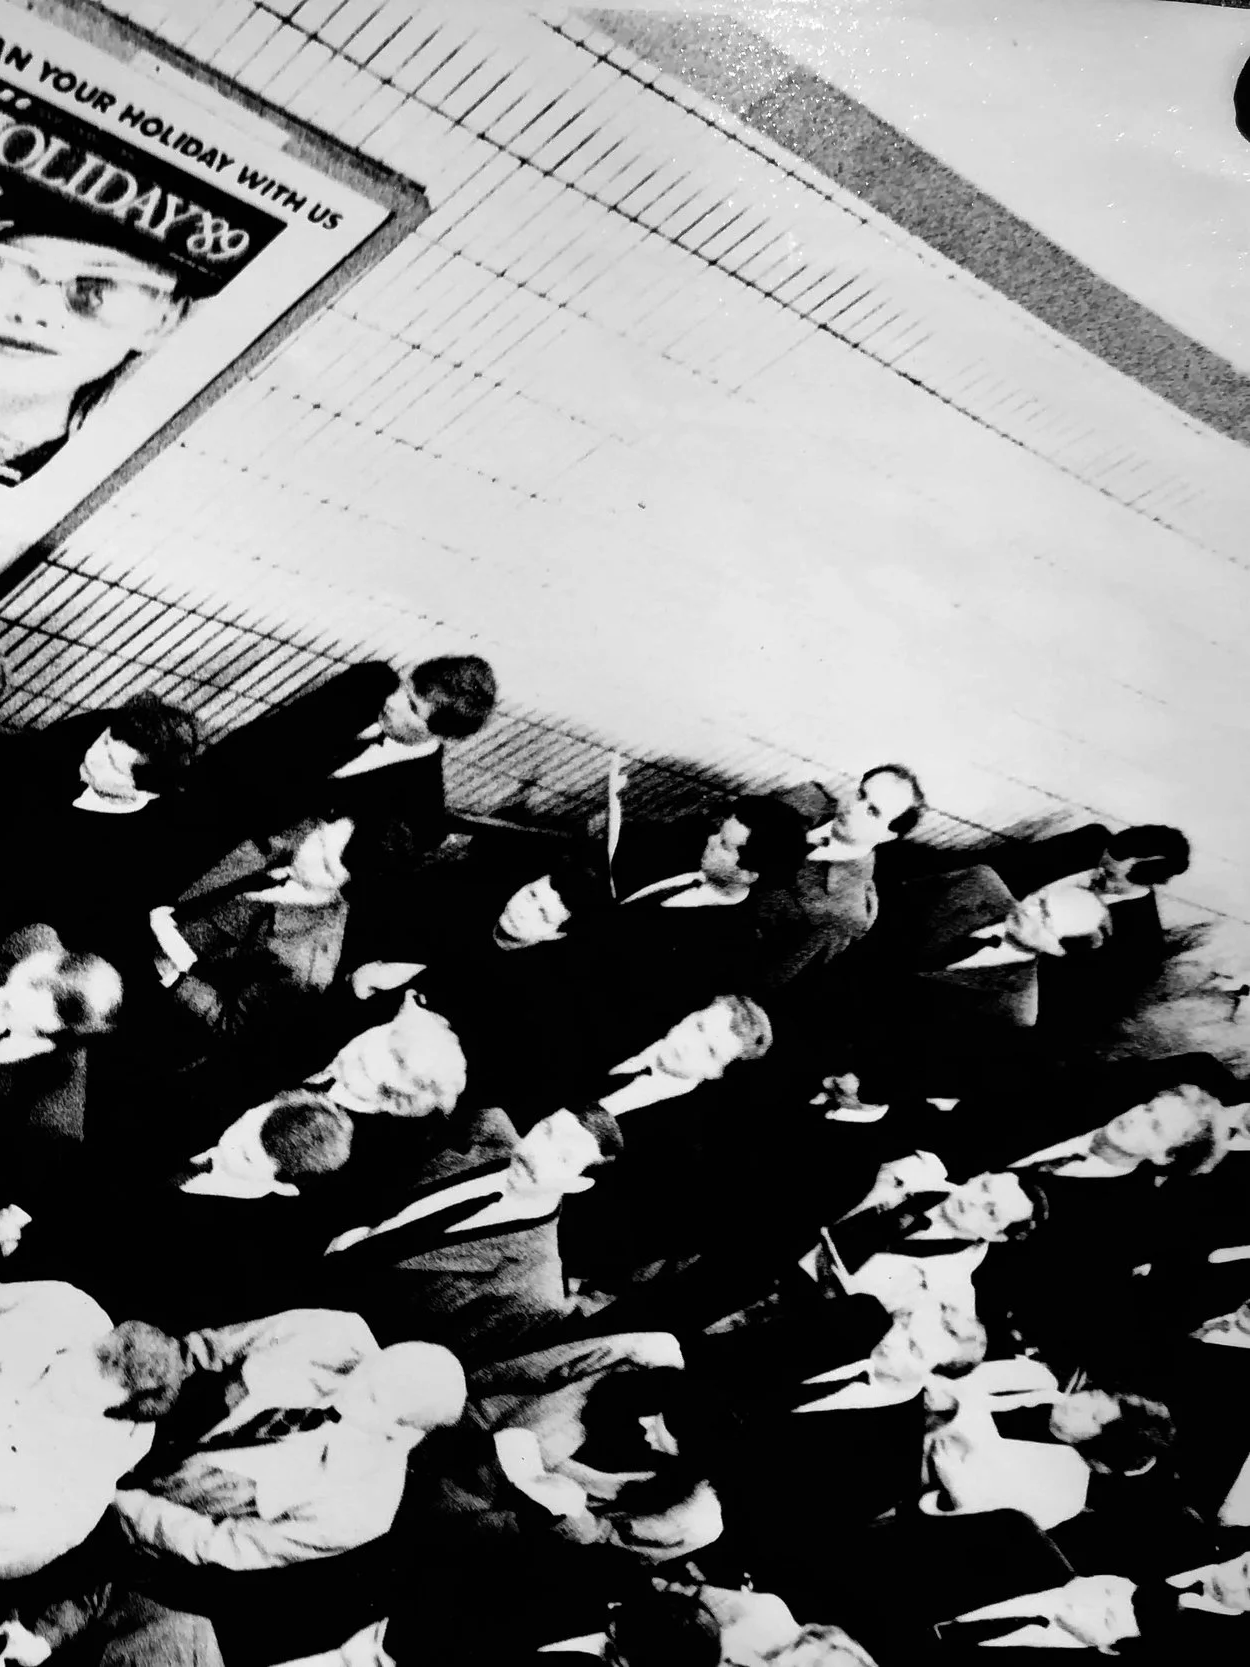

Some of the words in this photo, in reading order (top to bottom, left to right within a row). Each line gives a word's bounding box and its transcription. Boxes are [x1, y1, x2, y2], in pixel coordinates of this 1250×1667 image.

[38, 60, 117, 114] YOUR
[119, 103, 237, 172] HOLIDAY
[237, 165, 309, 214] WITH
[308, 203, 344, 231] US
